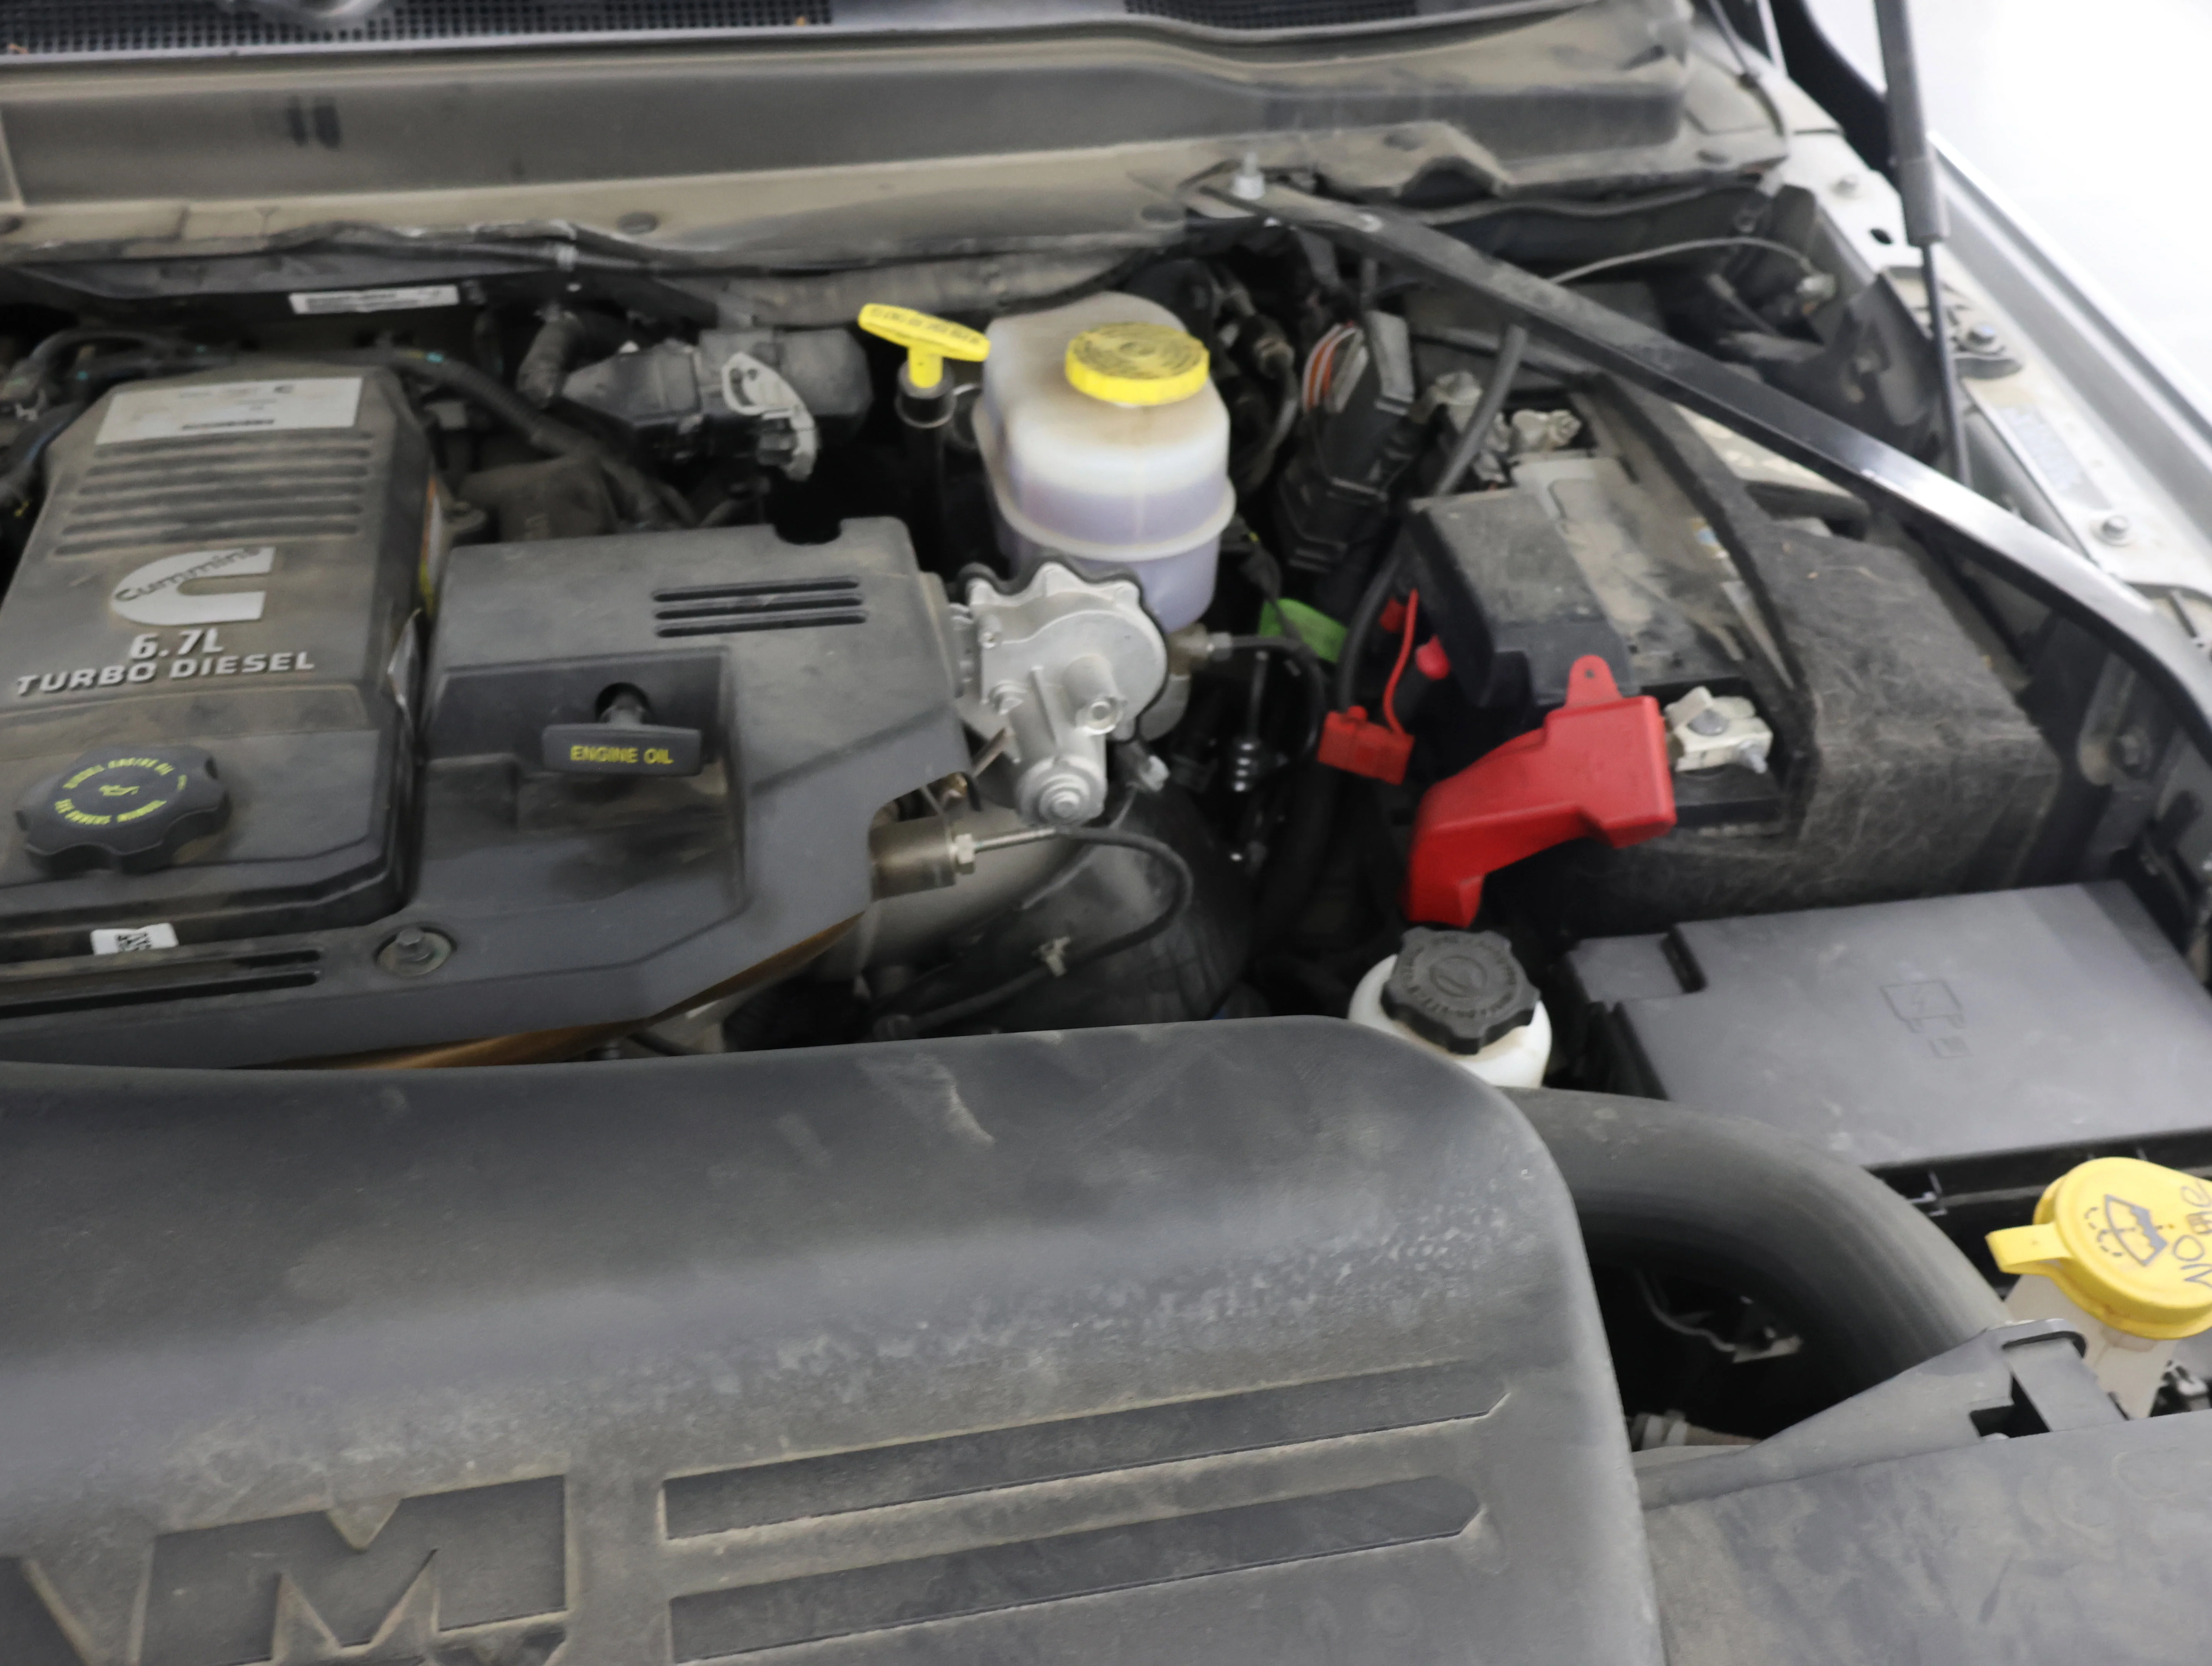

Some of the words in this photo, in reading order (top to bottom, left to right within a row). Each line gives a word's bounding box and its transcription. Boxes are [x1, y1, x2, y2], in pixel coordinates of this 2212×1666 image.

[130, 627, 224, 660] 6.7L
[17, 661, 155, 695] TURBO
[169, 651, 315, 679] DIESEL
[570, 745, 639, 764] ENGINE
[643, 747, 674, 765] OIL
